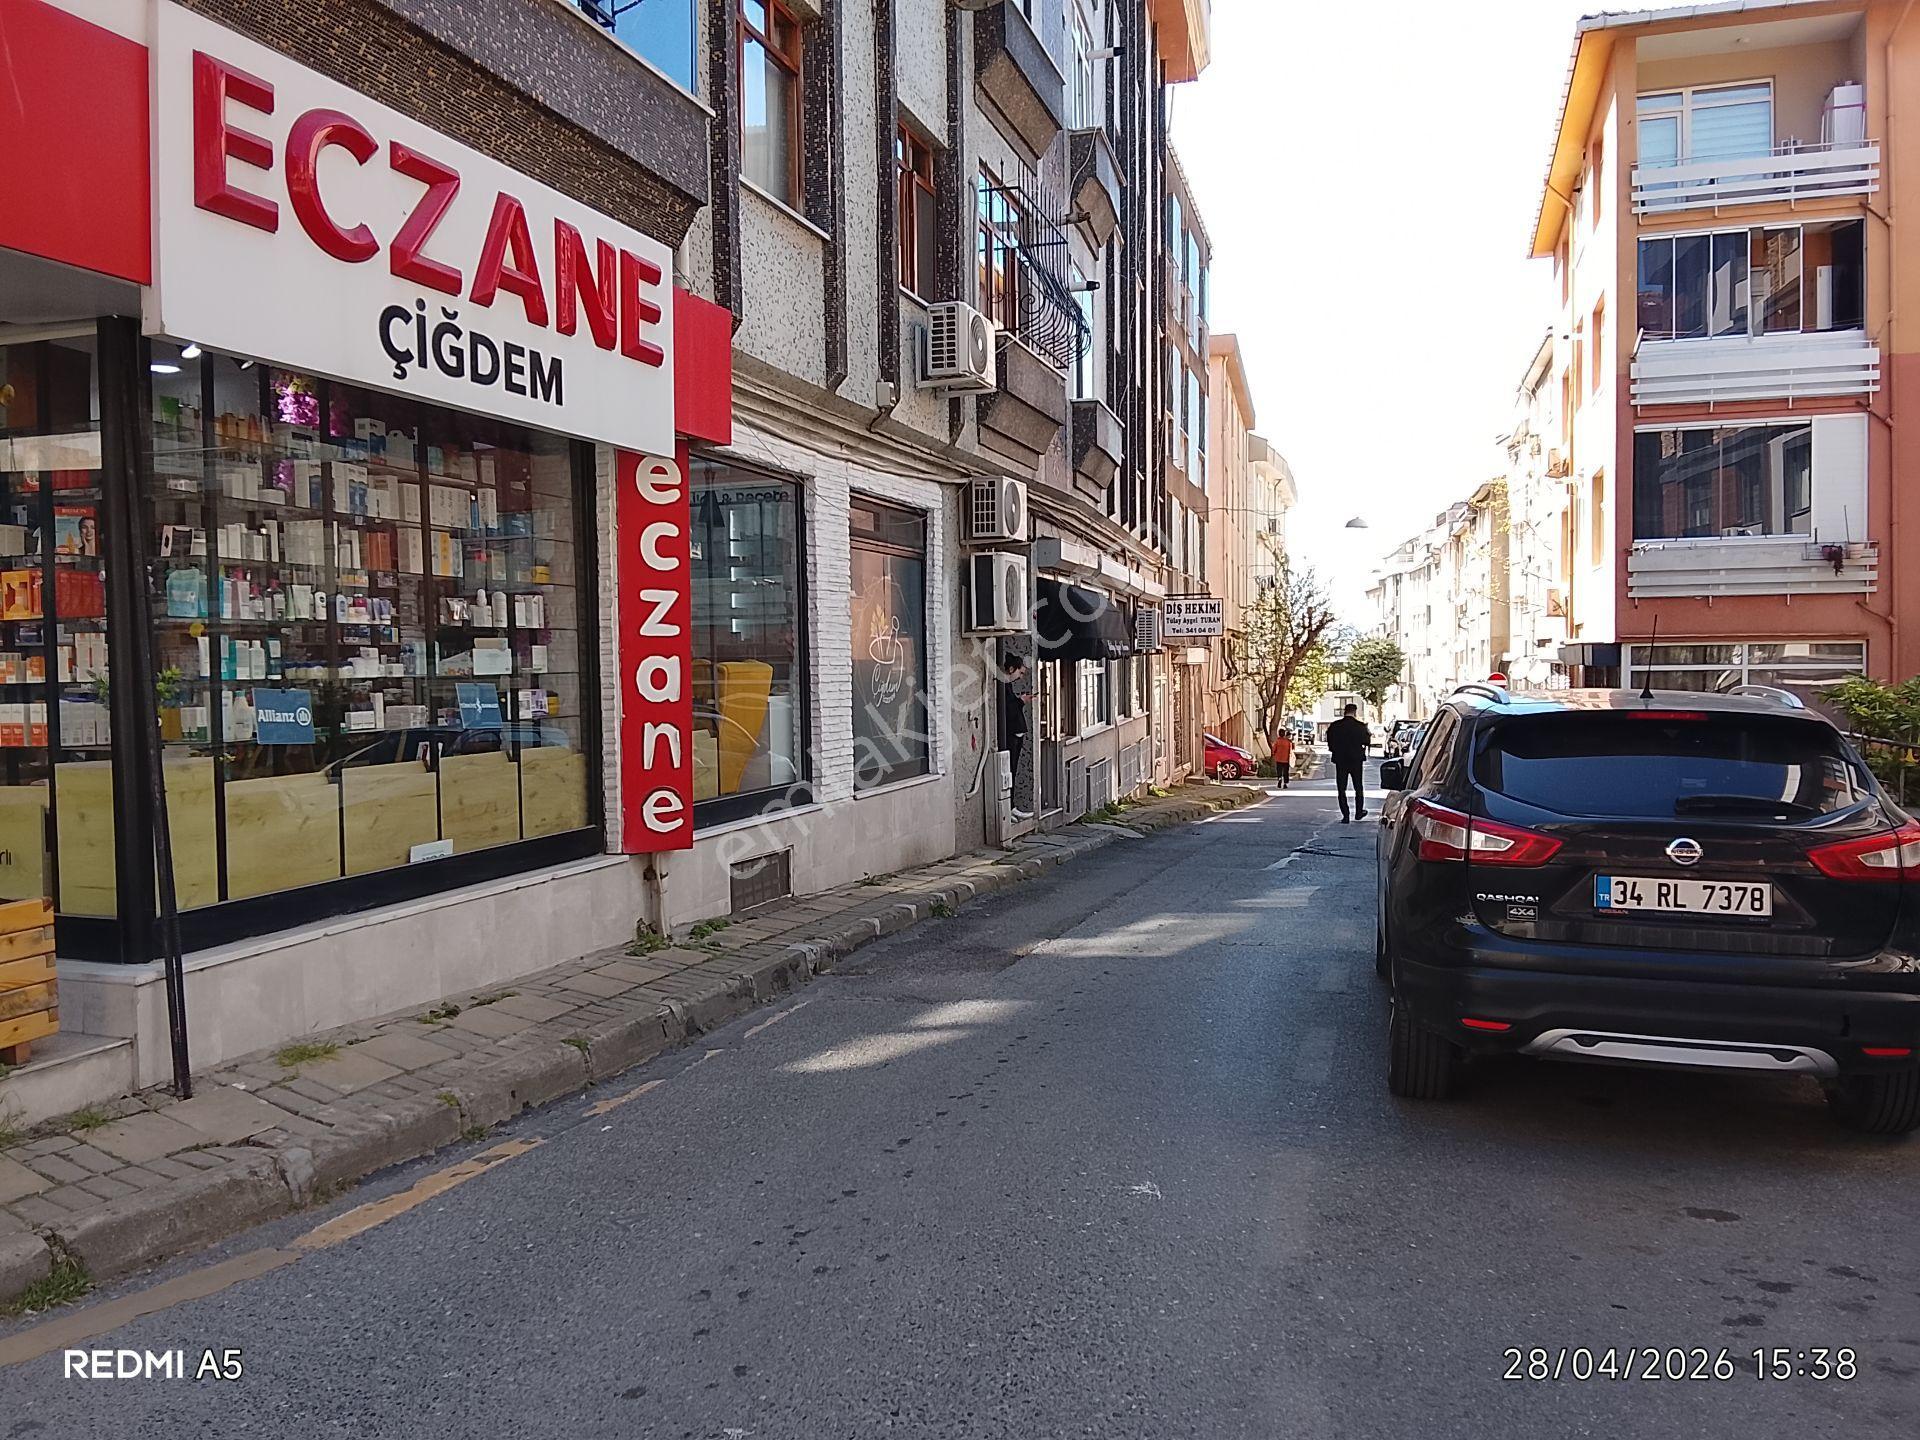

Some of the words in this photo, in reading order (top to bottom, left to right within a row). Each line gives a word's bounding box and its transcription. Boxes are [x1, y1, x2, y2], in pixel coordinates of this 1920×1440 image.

[192, 49, 664, 367] ECZANE
[378, 297, 564, 405] ÇİĞDEM
[1166, 602, 1183, 617] DİŞ
[1185, 601, 1221, 614] HEKİMİ
[635, 455, 685, 834] eczane
[257, 709, 295, 723] Allianz
[1476, 893, 1540, 903] QASHQAI
[1598, 893, 1610, 901] TR
[1614, 880, 1643, 906] 34
[1657, 882, 1687, 908] RL
[1702, 884, 1764, 912] 7378
